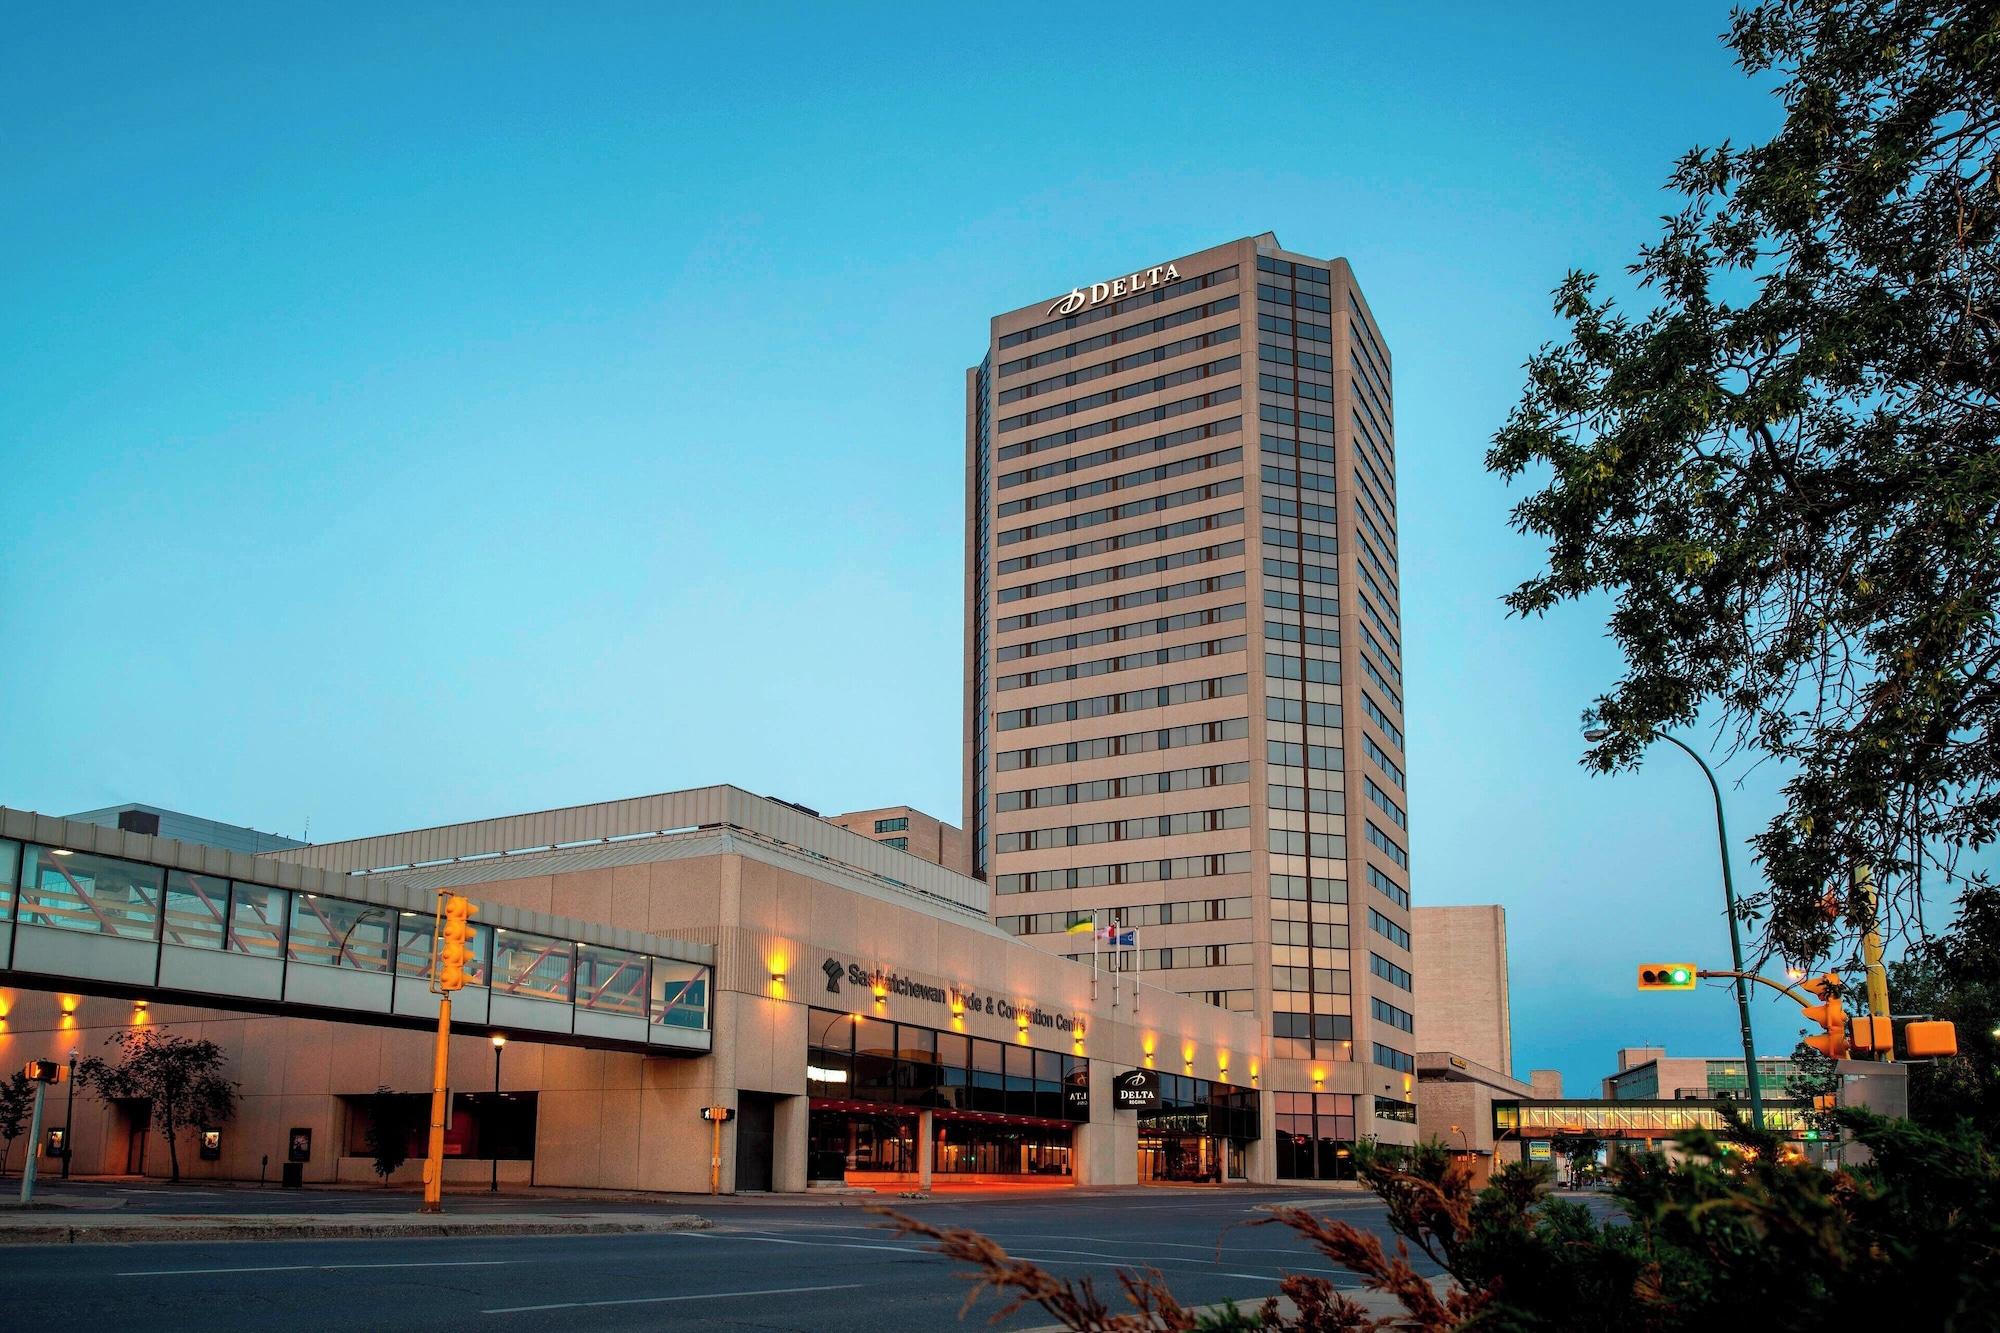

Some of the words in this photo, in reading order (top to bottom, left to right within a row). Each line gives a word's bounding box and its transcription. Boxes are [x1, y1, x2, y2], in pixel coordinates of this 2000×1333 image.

[1090, 264, 1181, 305] DELTA
[950, 986, 982, 1012] Tade
[985, 996, 994, 1015] &
[1120, 1090, 1155, 1100] DELTA
